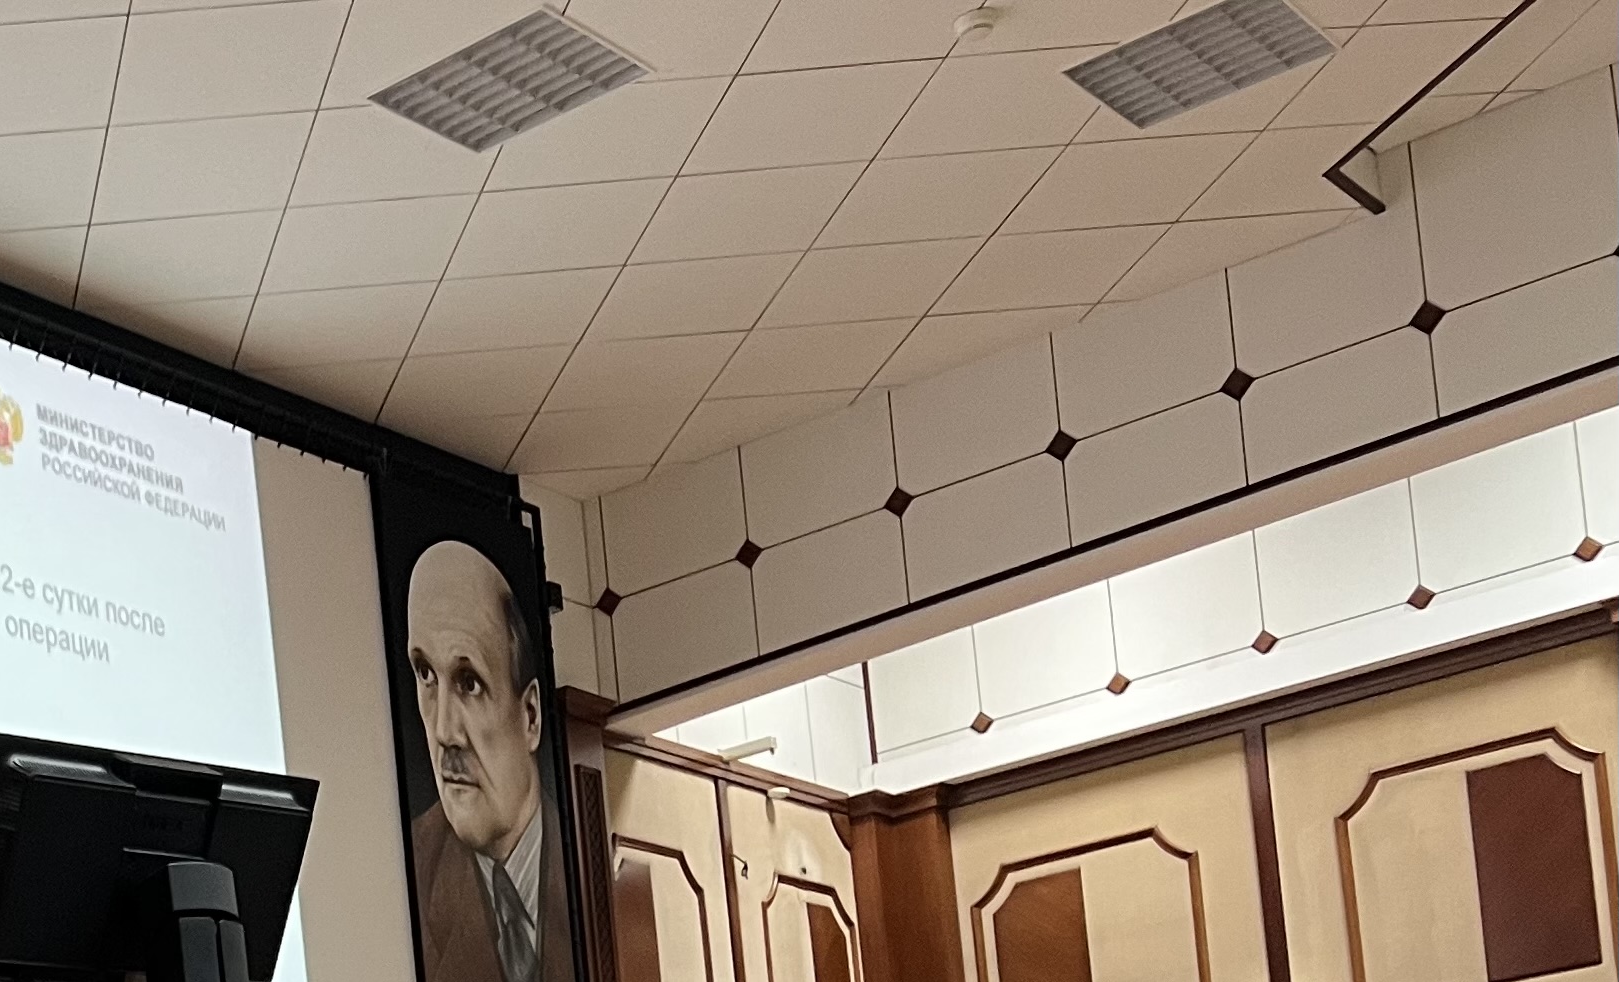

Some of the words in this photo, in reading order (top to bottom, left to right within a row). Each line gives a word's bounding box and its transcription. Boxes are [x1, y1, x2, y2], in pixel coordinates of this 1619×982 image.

[36, 404, 154, 461] МИНИСТЕРСТВО
[38, 429, 184, 493] ЗДРАВООХРАНЕНИЯ
[41, 452, 141, 502] РОССИЙСКОЙ
[144, 491, 226, 532] ФЕДЕРАЦИИ
[1, 564, 35, 600] 2-е
[42, 584, 98, 618] сутки
[105, 601, 165, 637] после
[5, 615, 110, 662] операции
